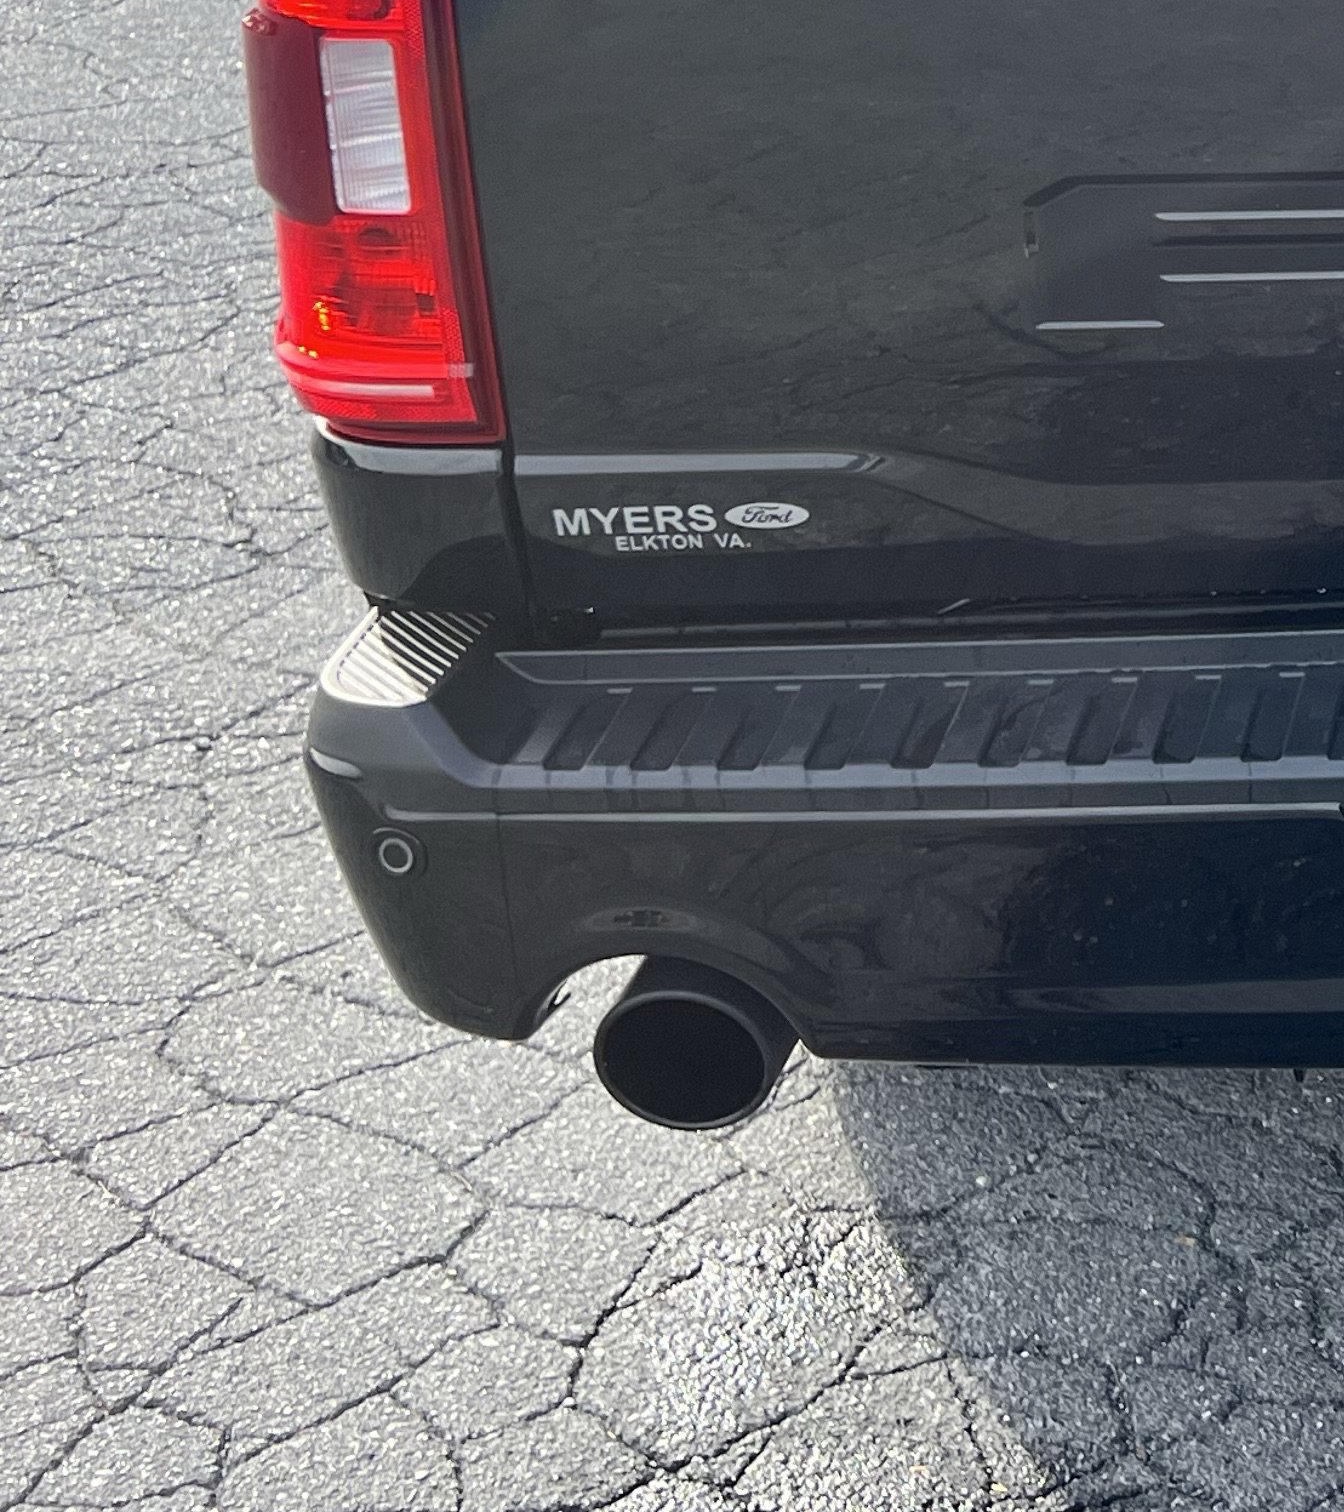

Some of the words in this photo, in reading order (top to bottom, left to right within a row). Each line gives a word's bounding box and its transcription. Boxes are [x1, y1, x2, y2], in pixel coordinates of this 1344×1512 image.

[553, 504, 717, 537] MYERS
[742, 505, 794, 525] Ford
[615, 534, 703, 551] ELKTON
[714, 532, 752, 549] VA.
